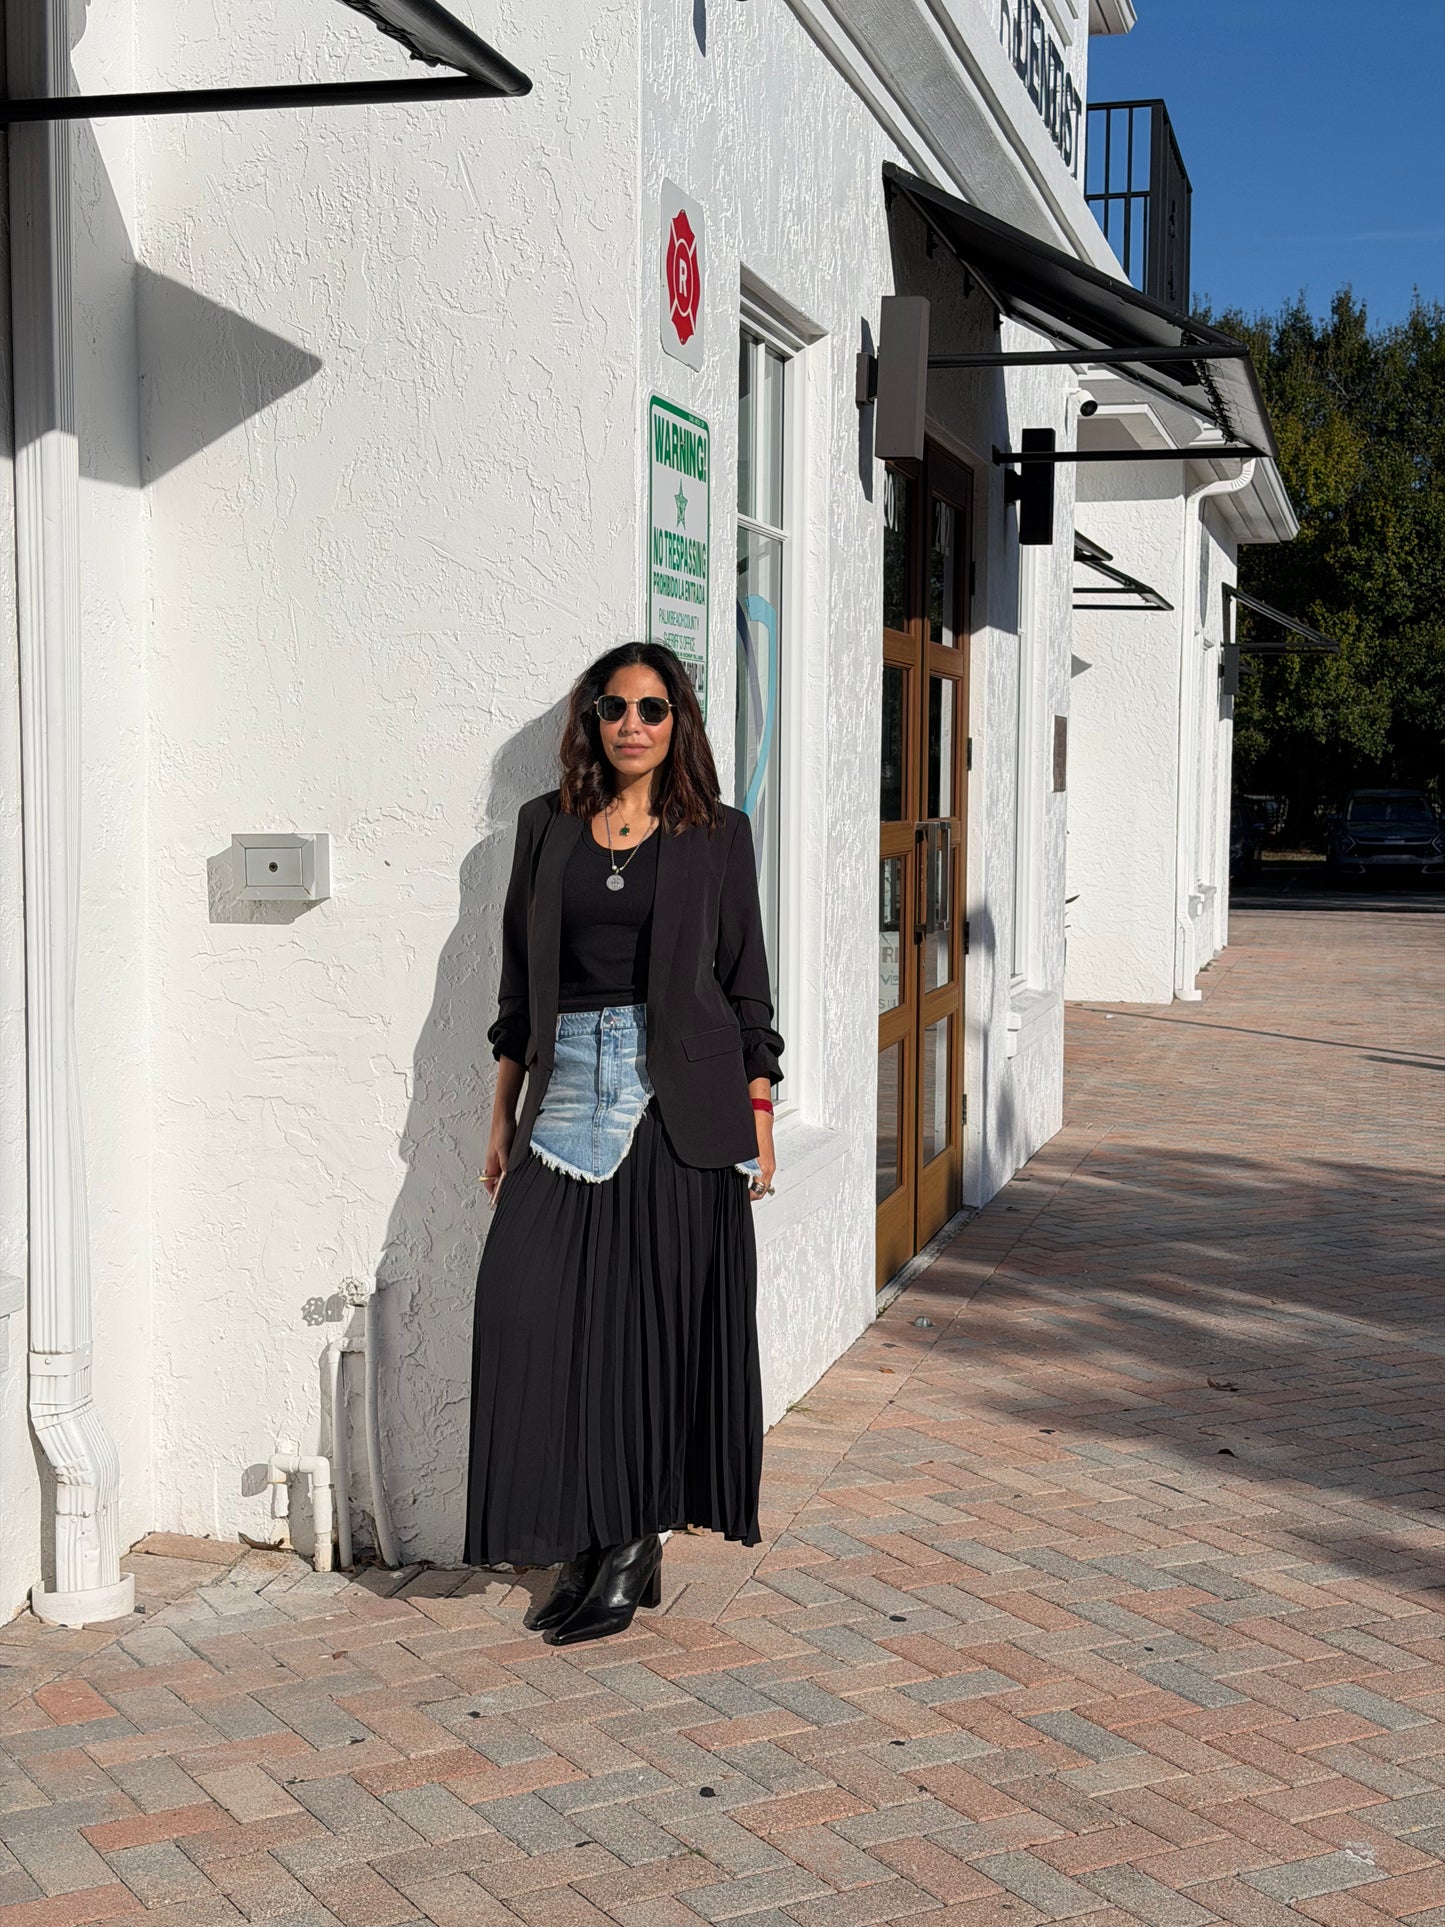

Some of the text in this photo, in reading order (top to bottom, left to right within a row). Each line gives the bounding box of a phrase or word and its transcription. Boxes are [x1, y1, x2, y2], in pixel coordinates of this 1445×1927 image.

[679, 258, 688, 298] R
[653, 413, 707, 483] WARNING!
[653, 526, 706, 580] NO TRESPASSING
